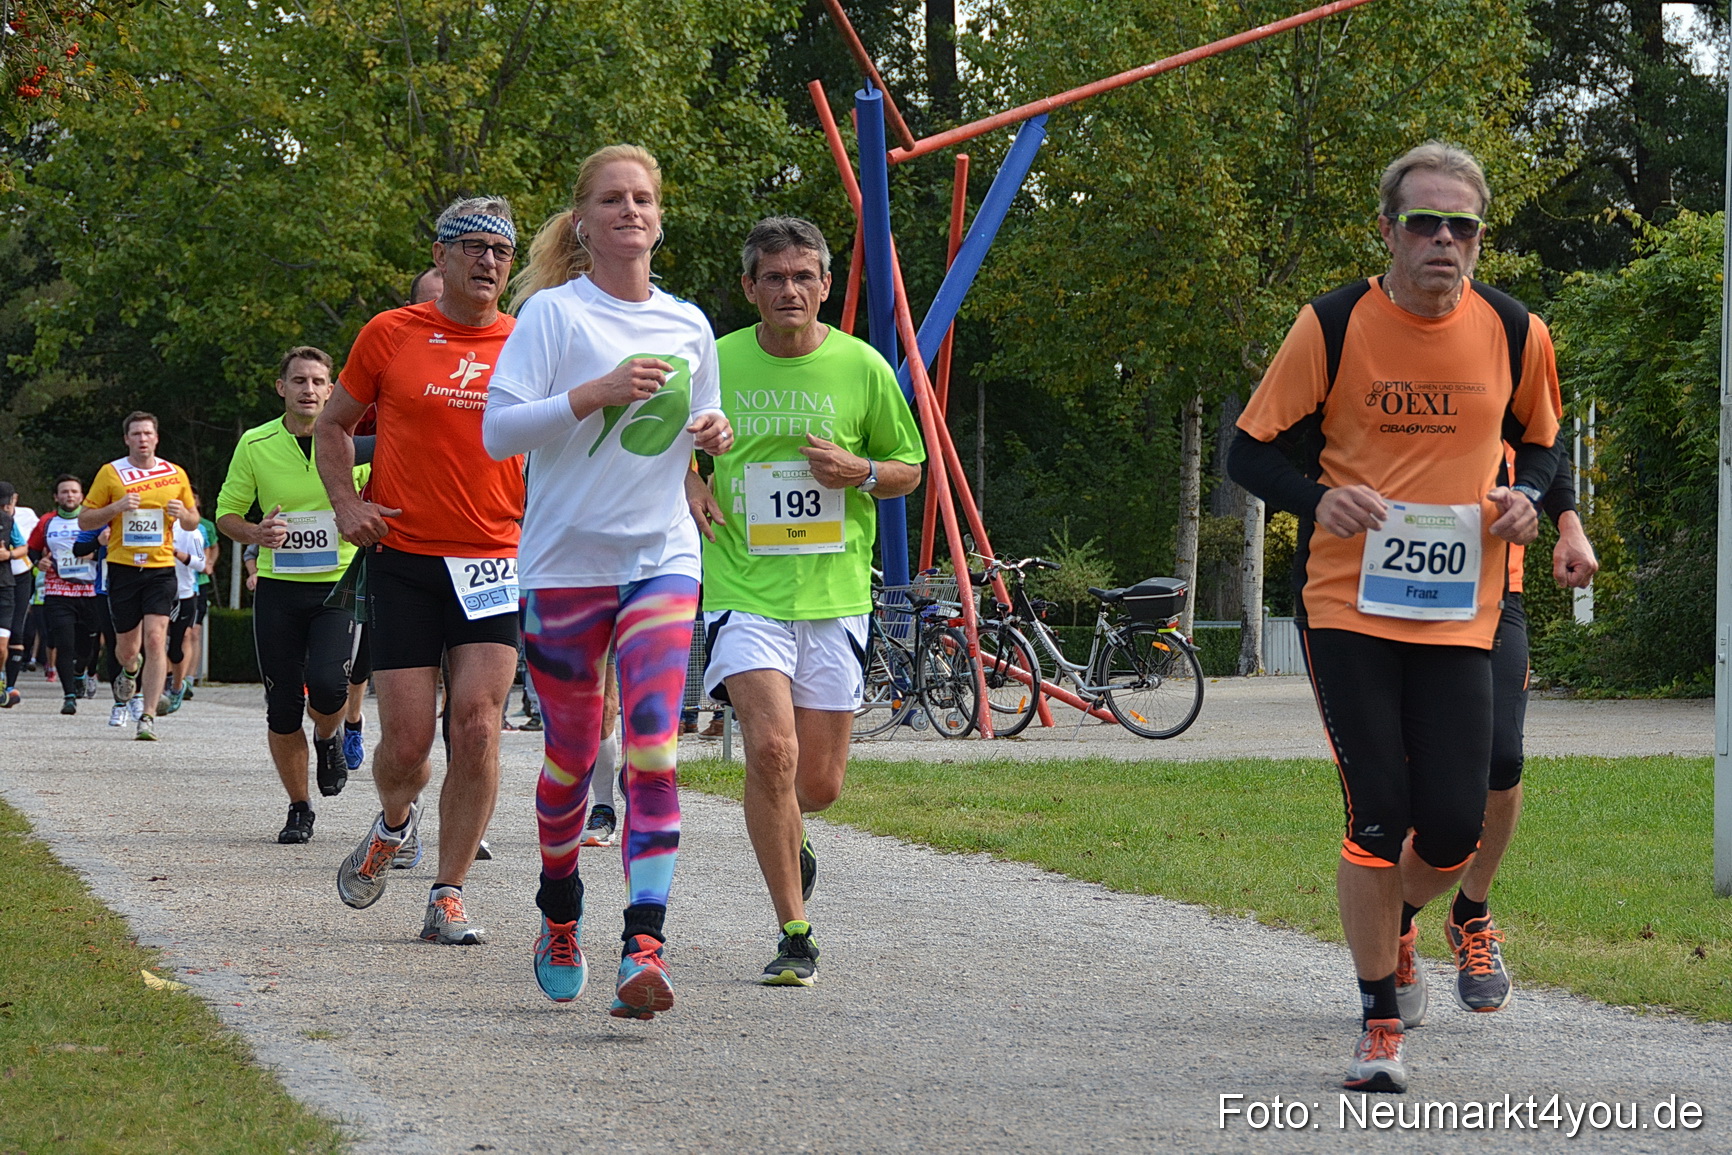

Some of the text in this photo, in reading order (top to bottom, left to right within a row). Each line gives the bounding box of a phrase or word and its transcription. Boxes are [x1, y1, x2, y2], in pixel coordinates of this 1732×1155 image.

[734, 389, 836, 414] NOVINA
[1381, 392, 1458, 415] OEXL
[736, 416, 834, 440] HOTELS
[1420, 425, 1457, 434] VISION
[769, 490, 822, 518] 193
[128, 520, 158, 532] 2624
[786, 528, 807, 538] Tom
[281, 529, 328, 549] 2998
[1382, 537, 1466, 575] 2560
[1406, 585, 1438, 599] Franz
